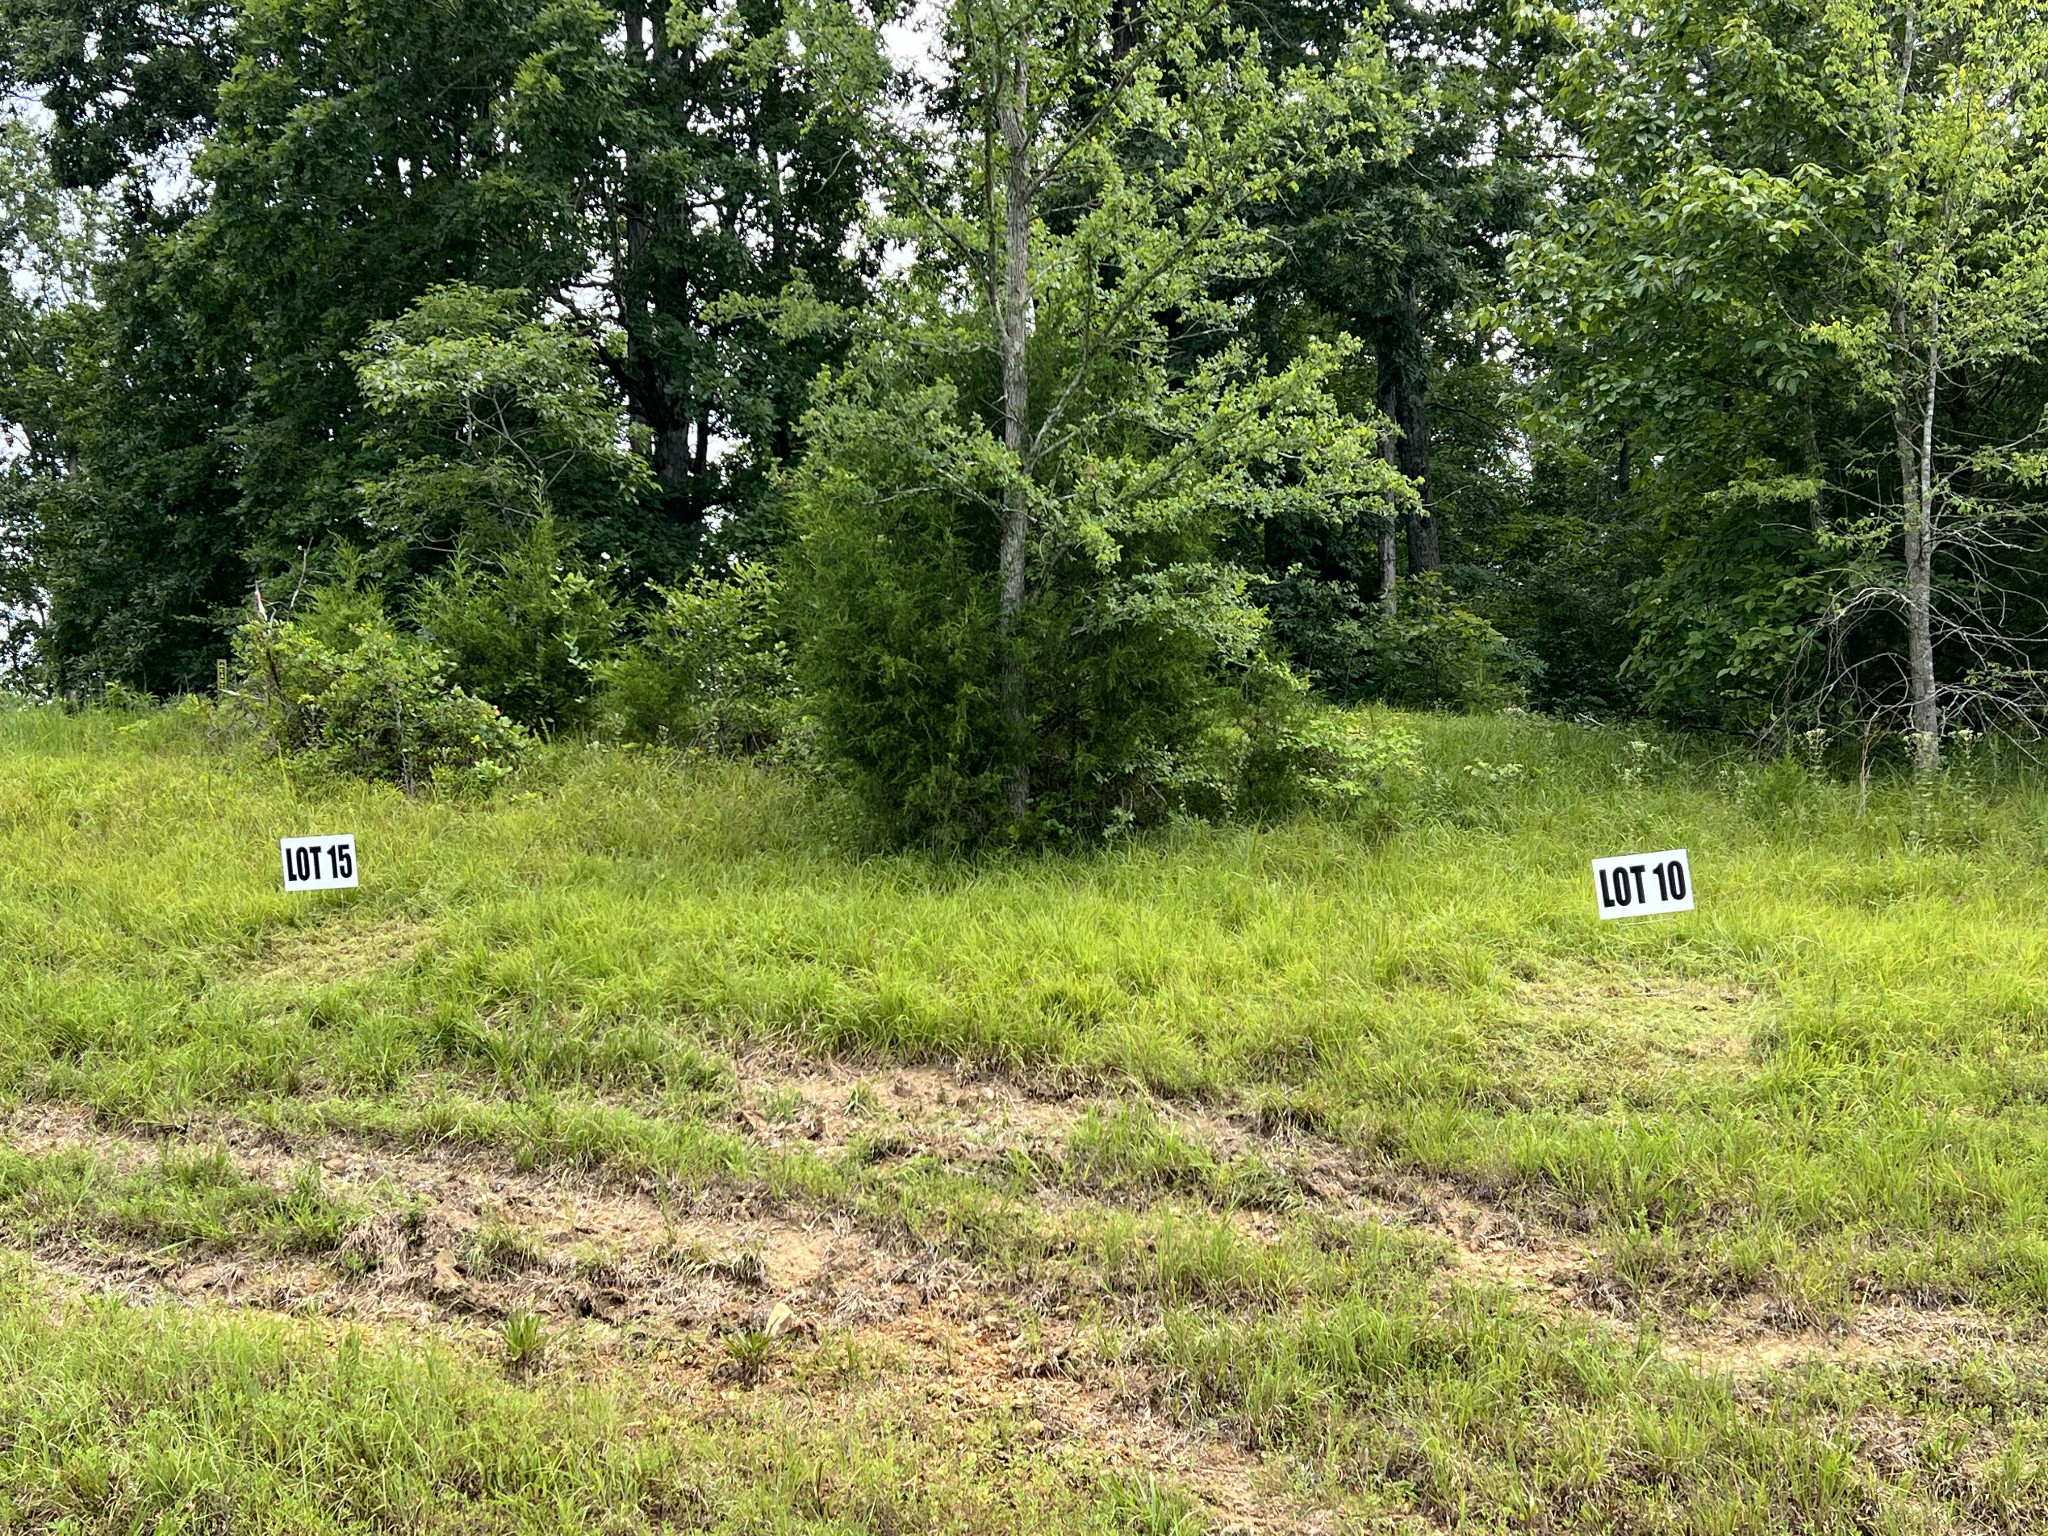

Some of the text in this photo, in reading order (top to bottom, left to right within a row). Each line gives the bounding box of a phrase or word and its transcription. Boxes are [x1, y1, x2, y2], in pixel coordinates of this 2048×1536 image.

[285, 844, 353, 882] LOT 15
[1599, 860, 1687, 908] LOT 10
